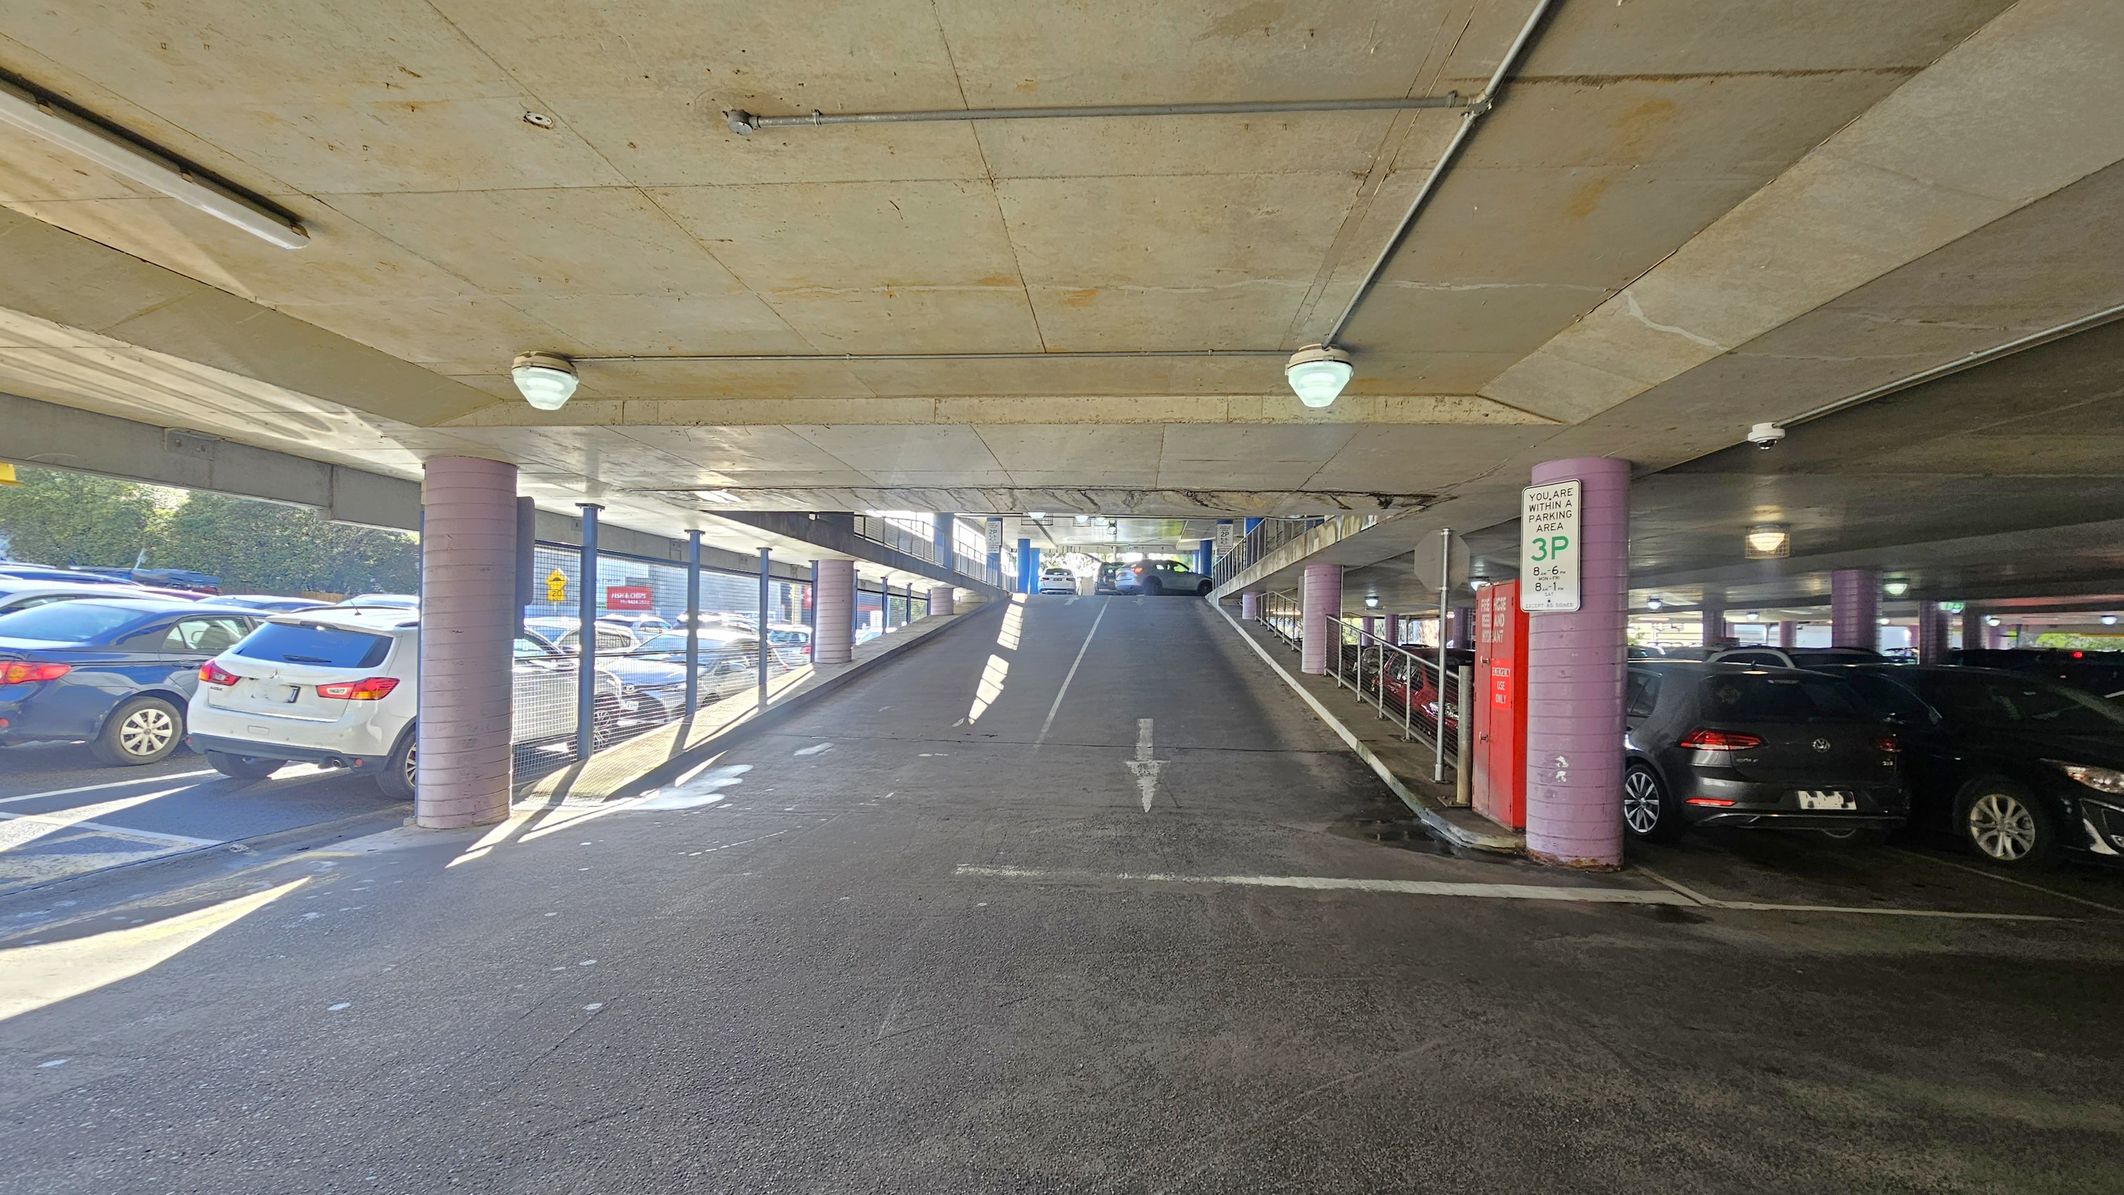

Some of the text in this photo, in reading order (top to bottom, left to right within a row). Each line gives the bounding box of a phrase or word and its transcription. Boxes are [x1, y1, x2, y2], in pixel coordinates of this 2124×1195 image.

[1529, 487, 1573, 501] YOU ARE
[1529, 499, 1573, 512] WITHIN A
[1528, 510, 1572, 523] PARKING
[1536, 522, 1564, 533] AREA
[1531, 536, 1569, 561] 3P
